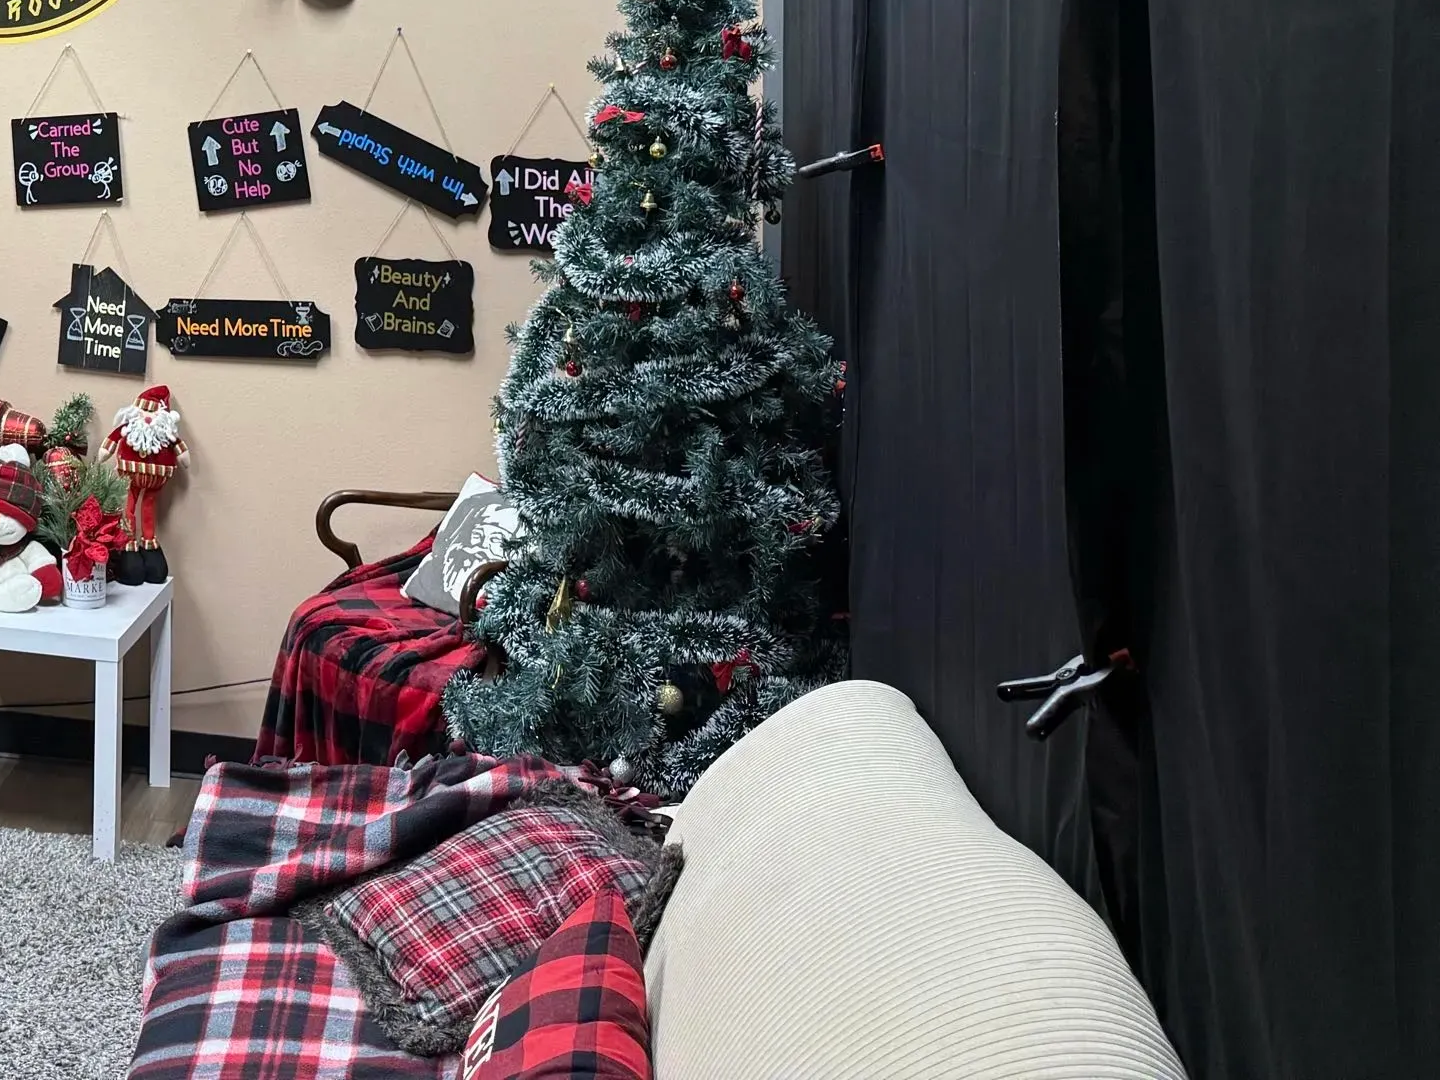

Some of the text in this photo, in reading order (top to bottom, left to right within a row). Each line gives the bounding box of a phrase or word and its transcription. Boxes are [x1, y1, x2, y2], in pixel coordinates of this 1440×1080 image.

[38, 119, 91, 138] Carried
[222, 118, 260, 135] Cute
[50, 141, 81, 158] The
[231, 138, 260, 156] But
[338, 129, 393, 166] Stupid
[44, 161, 90, 178] Group
[238, 159, 262, 177] No
[397, 153, 435, 183] with
[514, 166, 520, 188] I
[524, 167, 560, 190] Did
[234, 180, 272, 200] Help
[534, 195, 575, 218] The
[380, 264, 443, 293] Beauty
[86, 294, 126, 317] Need
[392, 289, 431, 311] And
[83, 315, 124, 338] More
[177, 317, 313, 337] Need More Time
[383, 311, 436, 336] Brains
[83, 336, 121, 359] Time
